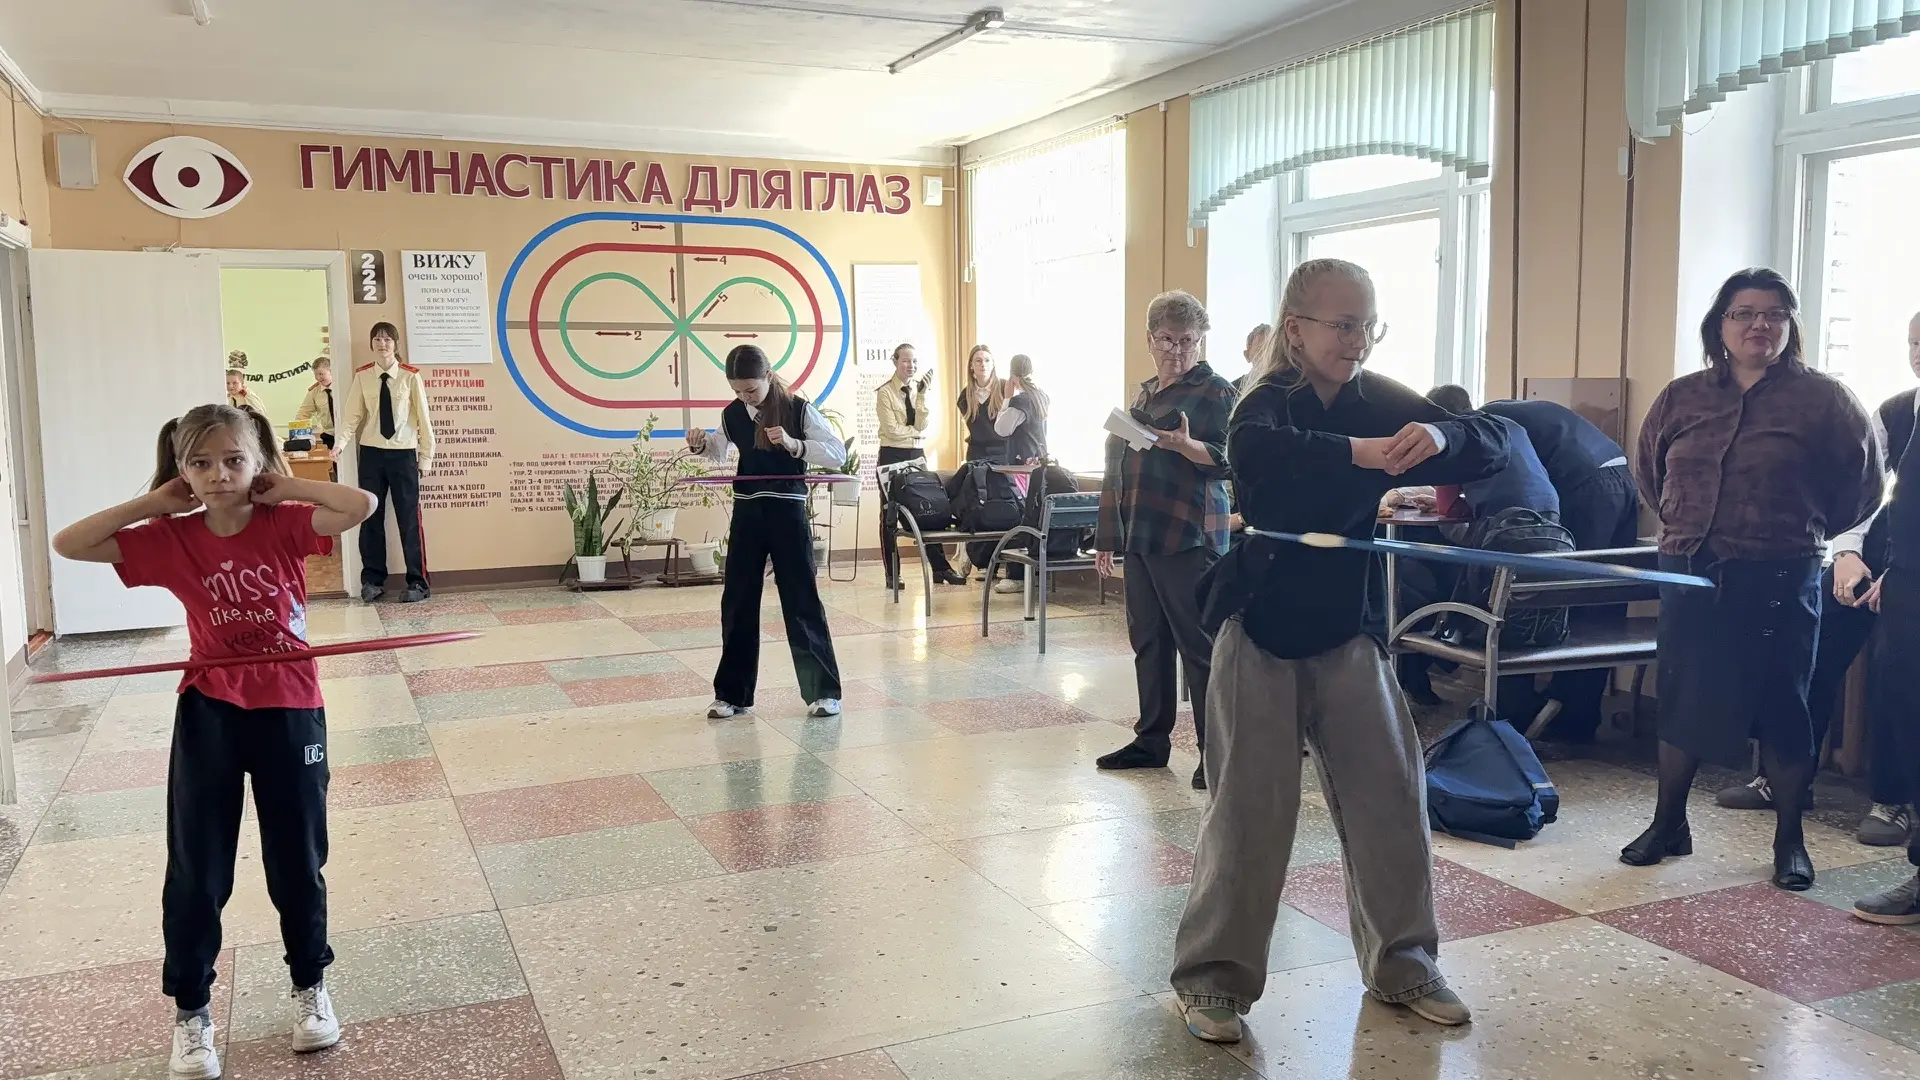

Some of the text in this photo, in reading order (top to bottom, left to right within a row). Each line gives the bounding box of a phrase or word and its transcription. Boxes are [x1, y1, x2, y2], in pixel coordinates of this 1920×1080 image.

[299, 144, 911, 215] ГИМНАСТИКА ДЛЯ ГЛАЗ
[631, 221, 640, 232] 3
[412, 253, 476, 269] ВИЖУ
[718, 255, 728, 265] 4
[440, 272, 483, 283] хорошо!
[718, 292, 729, 303] 5
[633, 330, 642, 341] 2
[243, 361, 312, 384] ТАЙ ДОСТИГАЙ
[432, 369, 470, 378] ПРОЧТИ
[668, 364, 673, 375] 1
[424, 379, 485, 389] НСТРУКЦИЮ
[439, 469, 468, 477] ГЛАЗА!
[419, 484, 445, 492] ПОСЛЕ
[420, 491, 502, 501] ПРАЖНЕНИЯ БЫСТРО
[423, 500, 488, 509] ЛЕГКО МОРГАЕМ!
[209, 607, 275, 626] like the
[304, 743, 324, 765] DG
